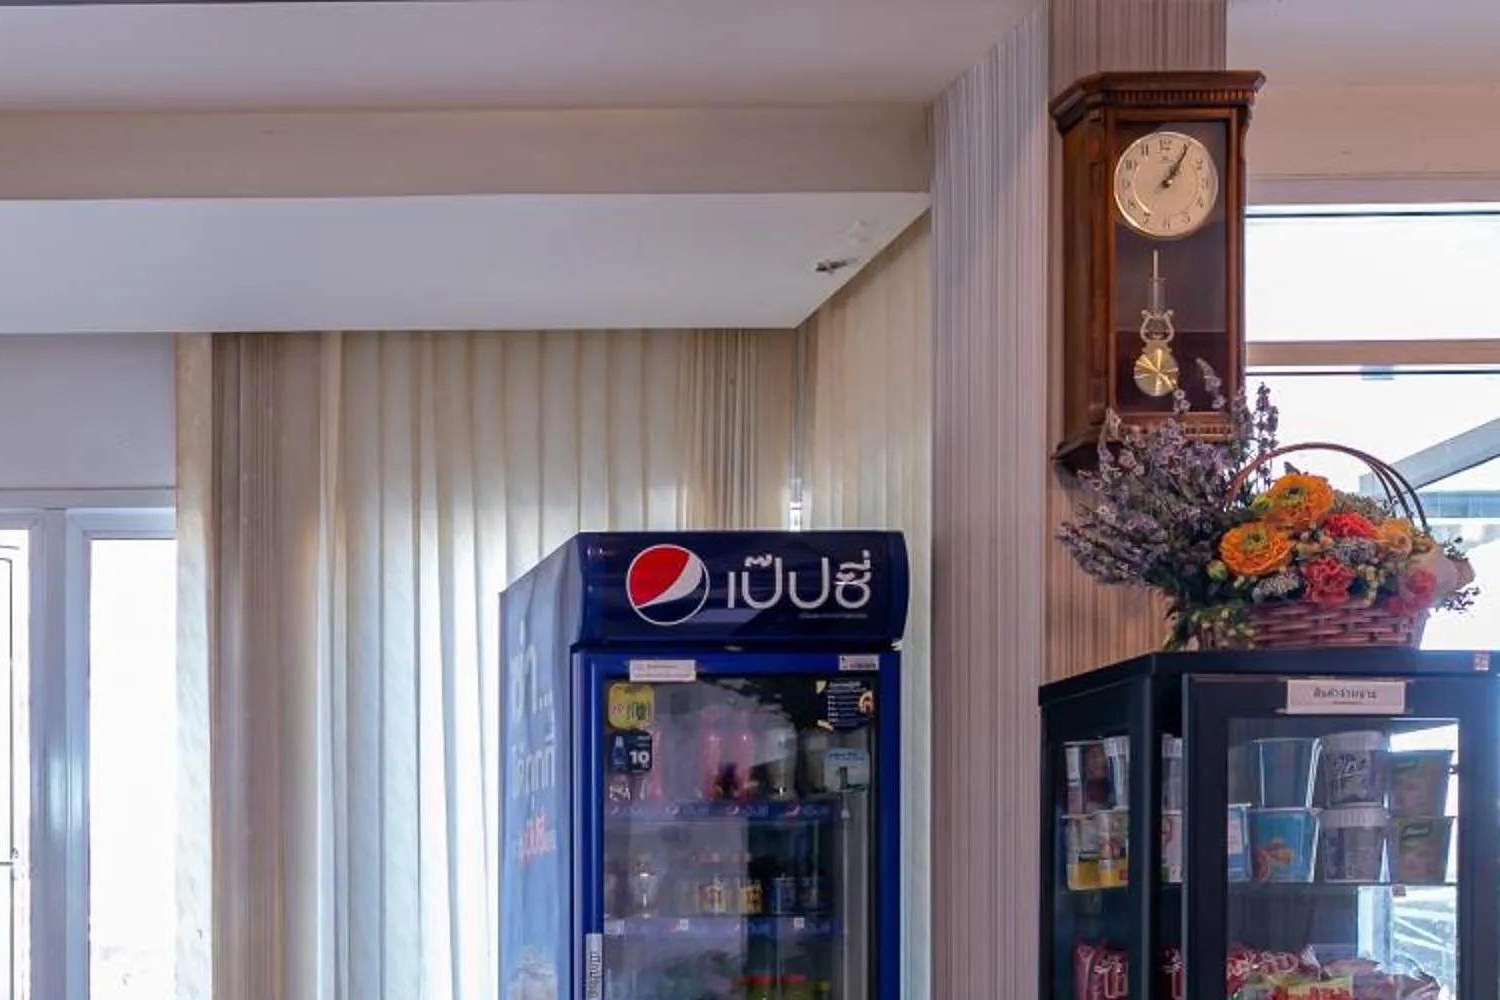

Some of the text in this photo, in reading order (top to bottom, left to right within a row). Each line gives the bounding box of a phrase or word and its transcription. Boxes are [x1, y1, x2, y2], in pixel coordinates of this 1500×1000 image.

[727, 549, 872, 610] เป๊ปซี่
[629, 750, 650, 765] 10
